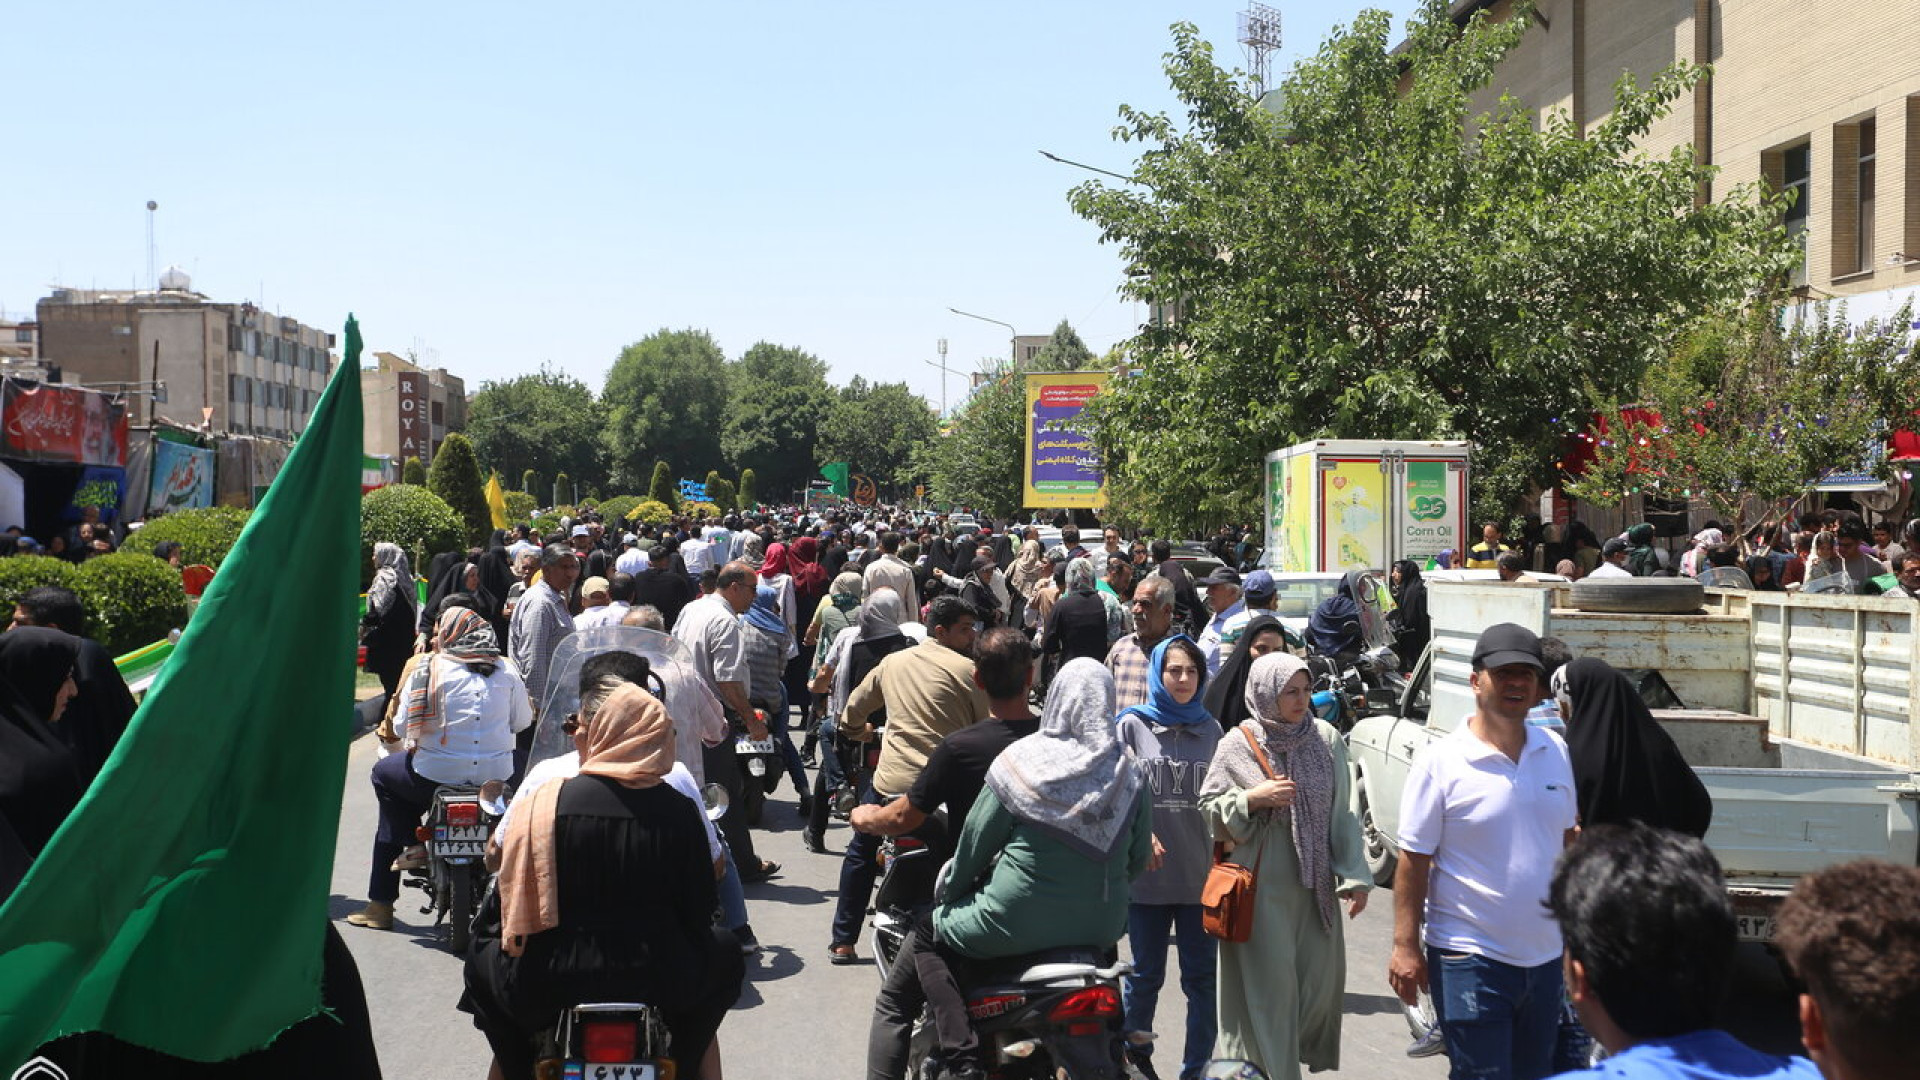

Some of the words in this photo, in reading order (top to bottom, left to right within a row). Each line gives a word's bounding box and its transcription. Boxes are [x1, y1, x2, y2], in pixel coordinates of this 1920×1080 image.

[401, 380, 415, 461] ROYA
[1407, 526, 1434, 536] Corn
[1437, 525, 1452, 536] Oil
